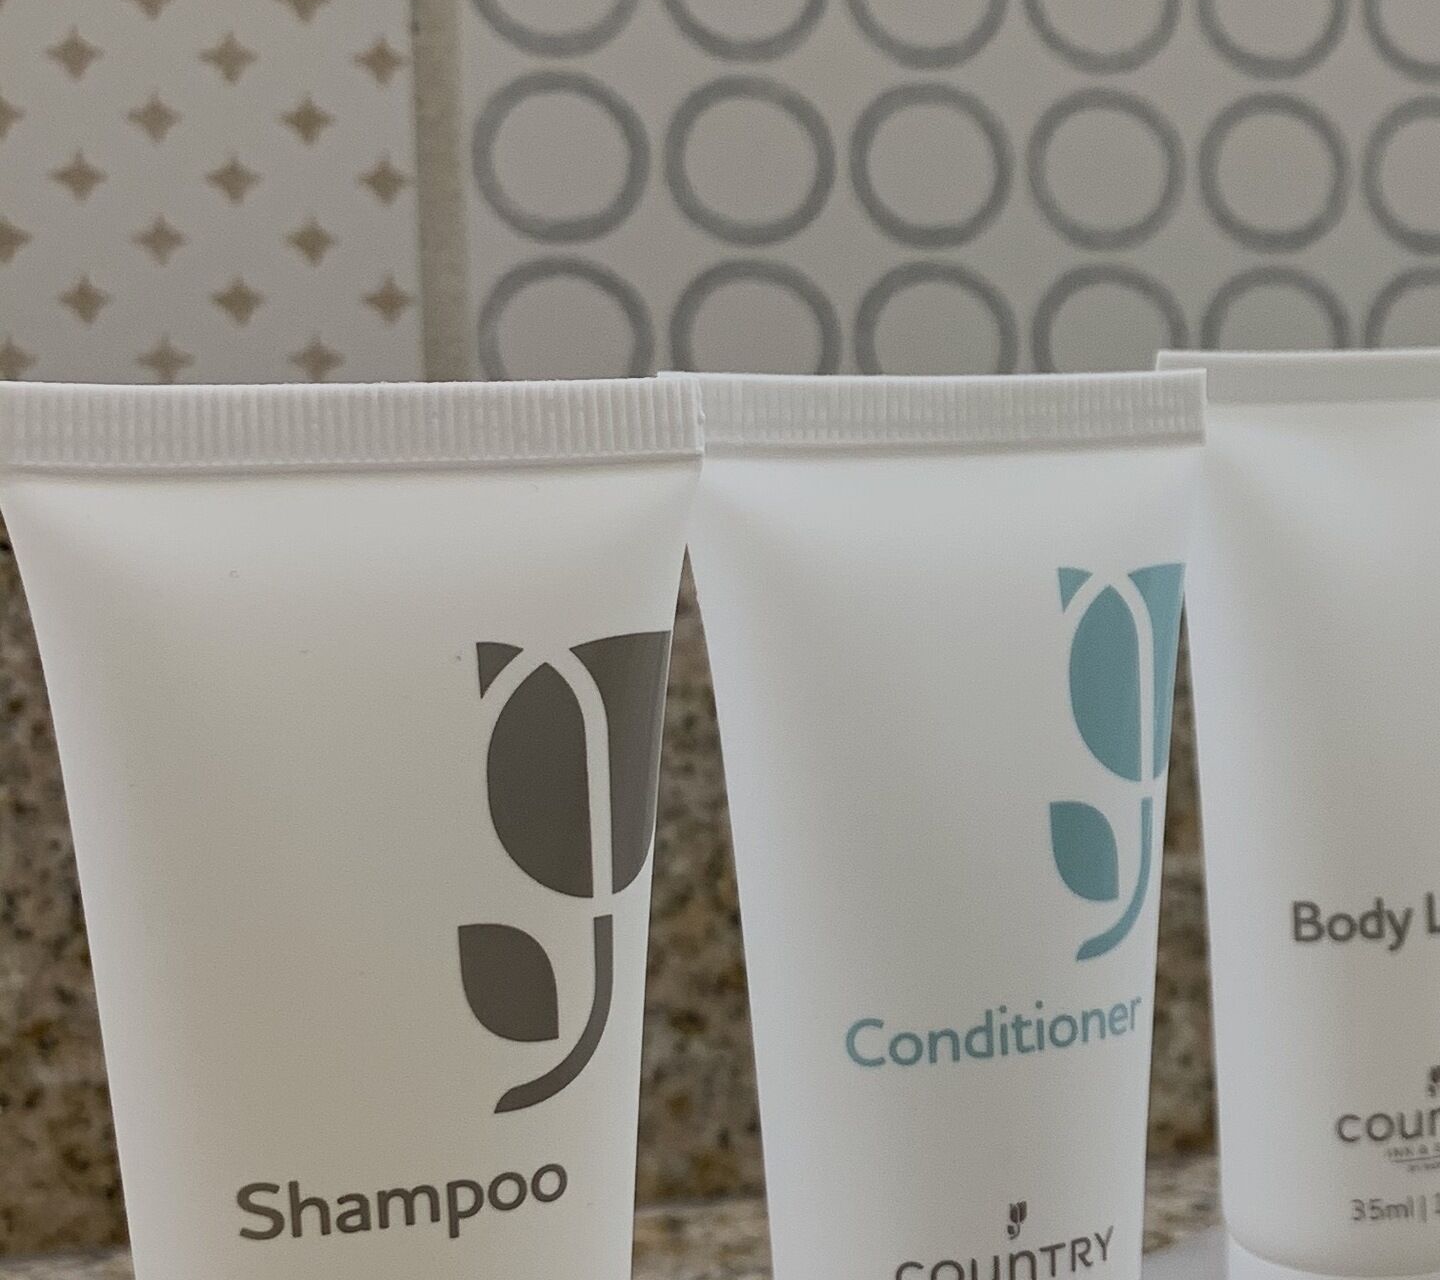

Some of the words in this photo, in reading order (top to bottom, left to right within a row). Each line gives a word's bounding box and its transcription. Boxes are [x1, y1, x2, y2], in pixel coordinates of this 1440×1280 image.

[1292, 896, 1414, 952] Body
[845, 996, 1142, 1068] Conditioner
[236, 1162, 568, 1240] Shampoo
